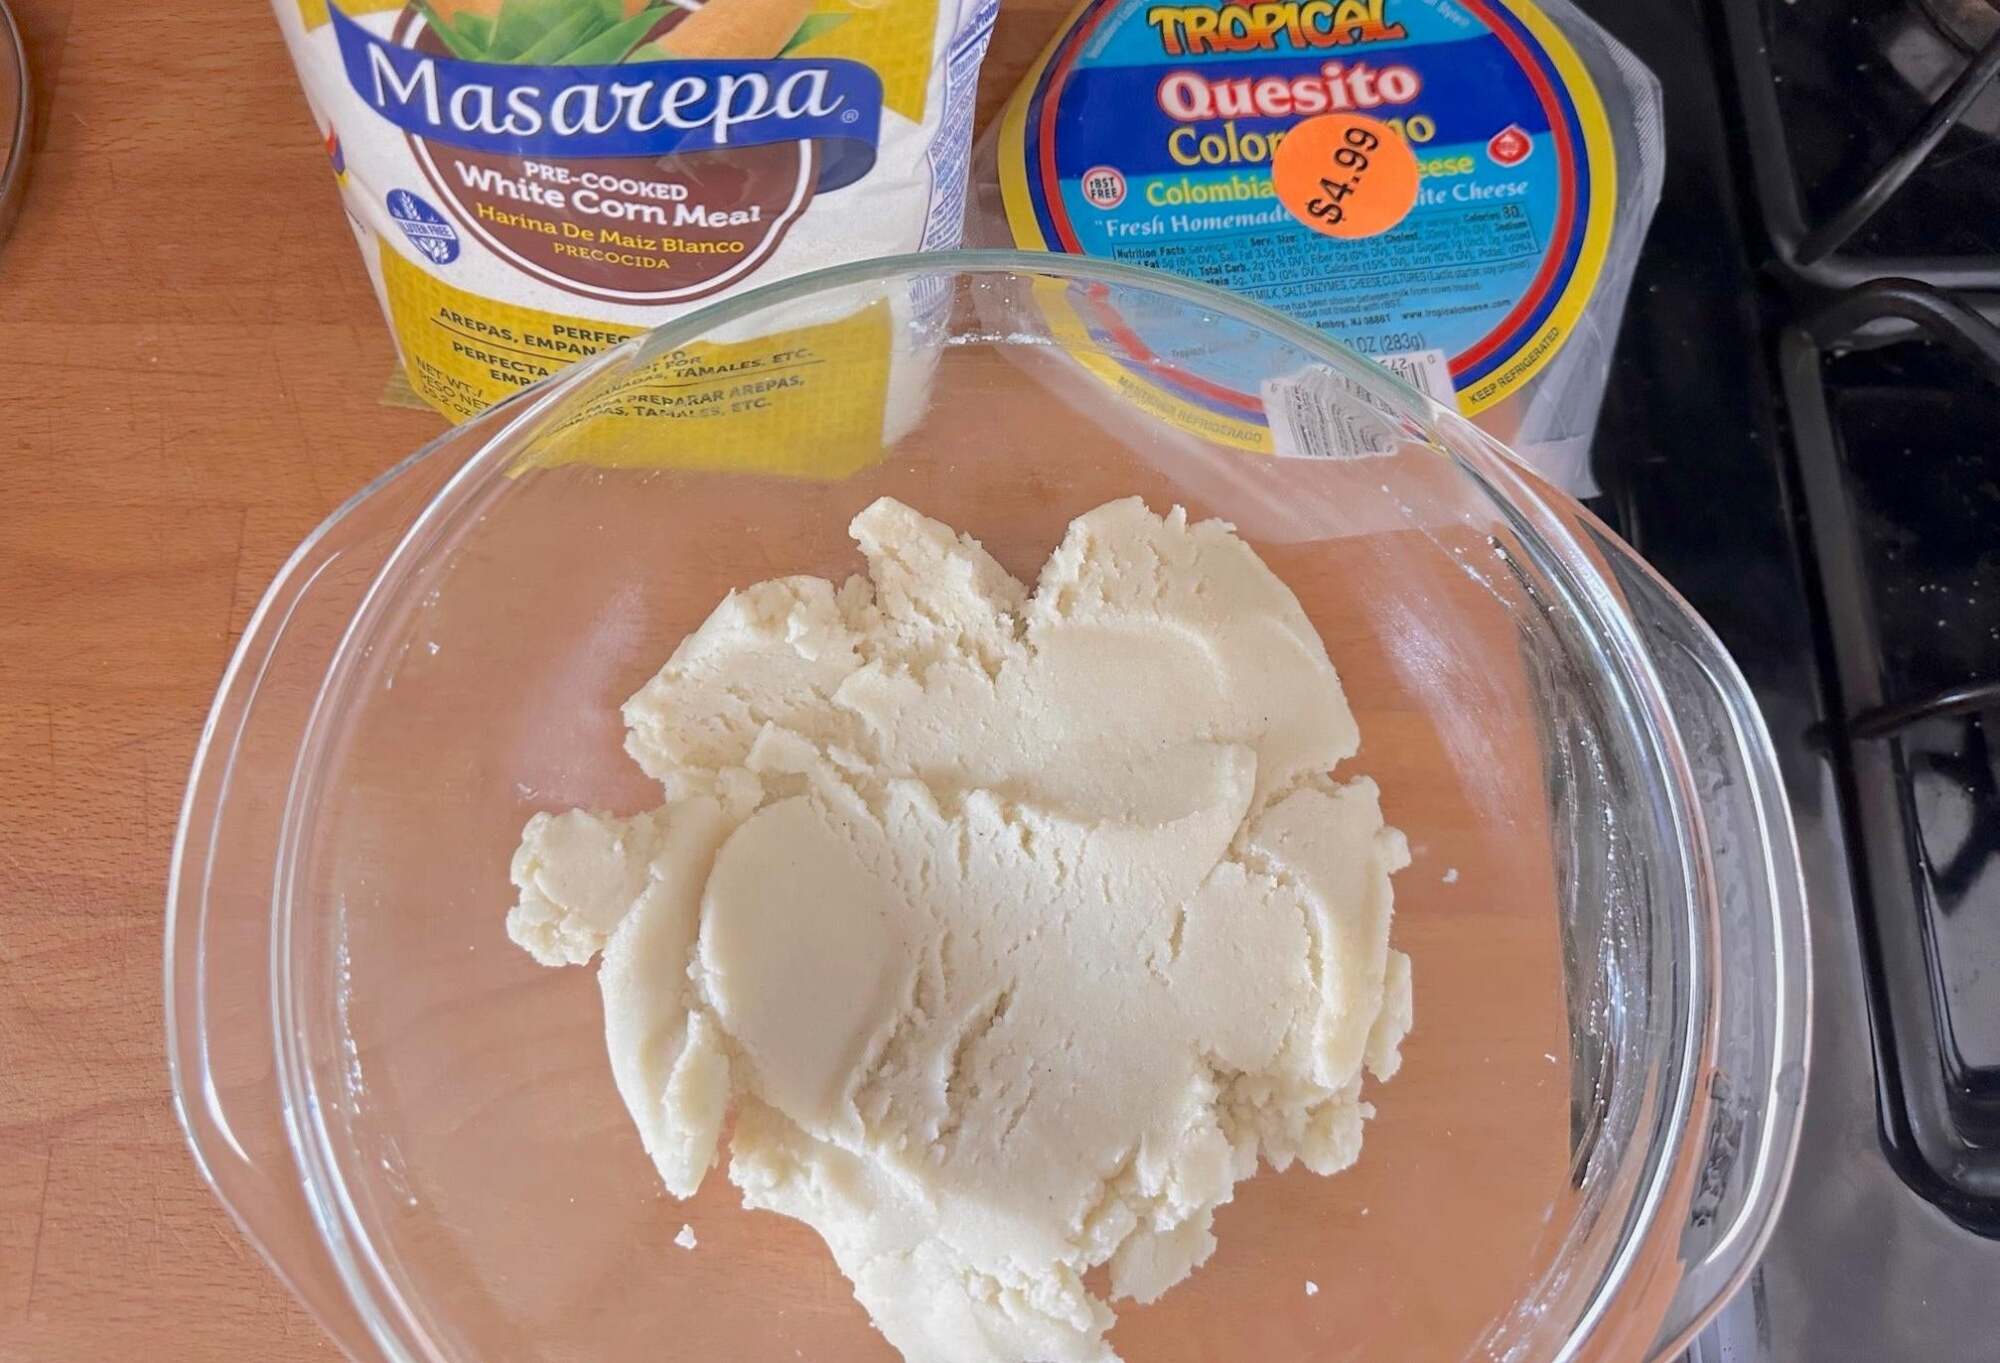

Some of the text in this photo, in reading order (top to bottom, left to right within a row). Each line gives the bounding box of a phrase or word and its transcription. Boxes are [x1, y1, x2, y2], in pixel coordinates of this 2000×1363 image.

[1148, 0, 1407, 55] TROPICAL
[366, 41, 846, 144] Masarepa
[1159, 61, 1420, 121] Quesito
[455, 159, 762, 228] White Corn Meal
[523, 160, 689, 201] PRE-COOKED
[1089, 176, 1115, 189] rBST
[1090, 187, 1118, 199] FREE
[1305, 127, 1379, 225] $4.99
[1452, 181, 1529, 202] Cheese
[475, 201, 558, 236] Harina
[560, 222, 595, 242] De
[661, 236, 745, 254] Blanco
[552, 241, 671, 270] PRECOCIDA
[1117, 247, 1157, 259] Nutrition
[1159, 245, 1185, 256] Facts
[1200, 265, 1223, 276] Total
[1256, 287, 1282, 301] MILK,
[440, 307, 519, 343] AREPAS,
[773, 348, 813, 364] ETC.
[1316, 319, 1350, 331] Amboy,
[1356, 336, 1377, 354] OZ
[1380, 331, 1426, 354] (283g)
[453, 340, 549, 378] PERFECTA
[1468, 326, 1560, 405] KEEP REFRIGERATED
